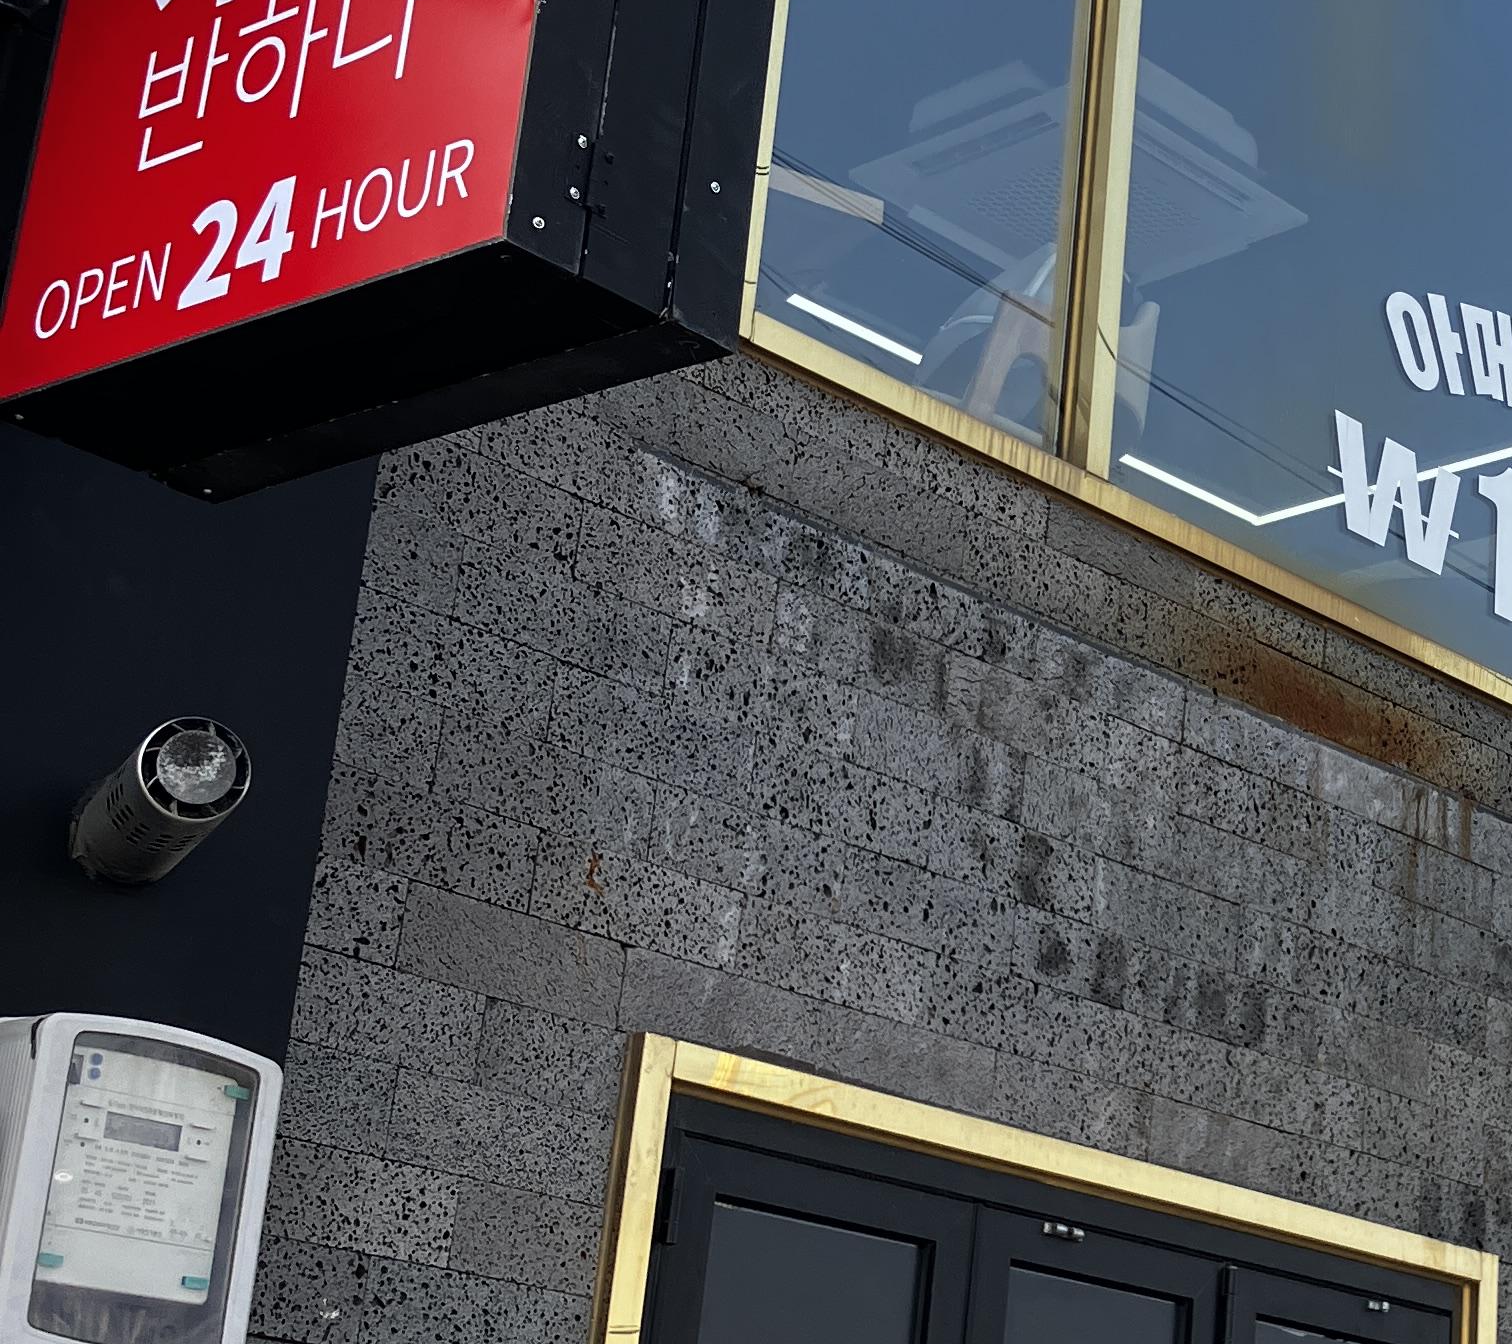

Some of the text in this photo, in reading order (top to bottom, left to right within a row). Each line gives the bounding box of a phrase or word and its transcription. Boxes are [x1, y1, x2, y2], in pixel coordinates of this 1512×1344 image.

[33, 138, 475, 341] OPEN 24 HOUR
